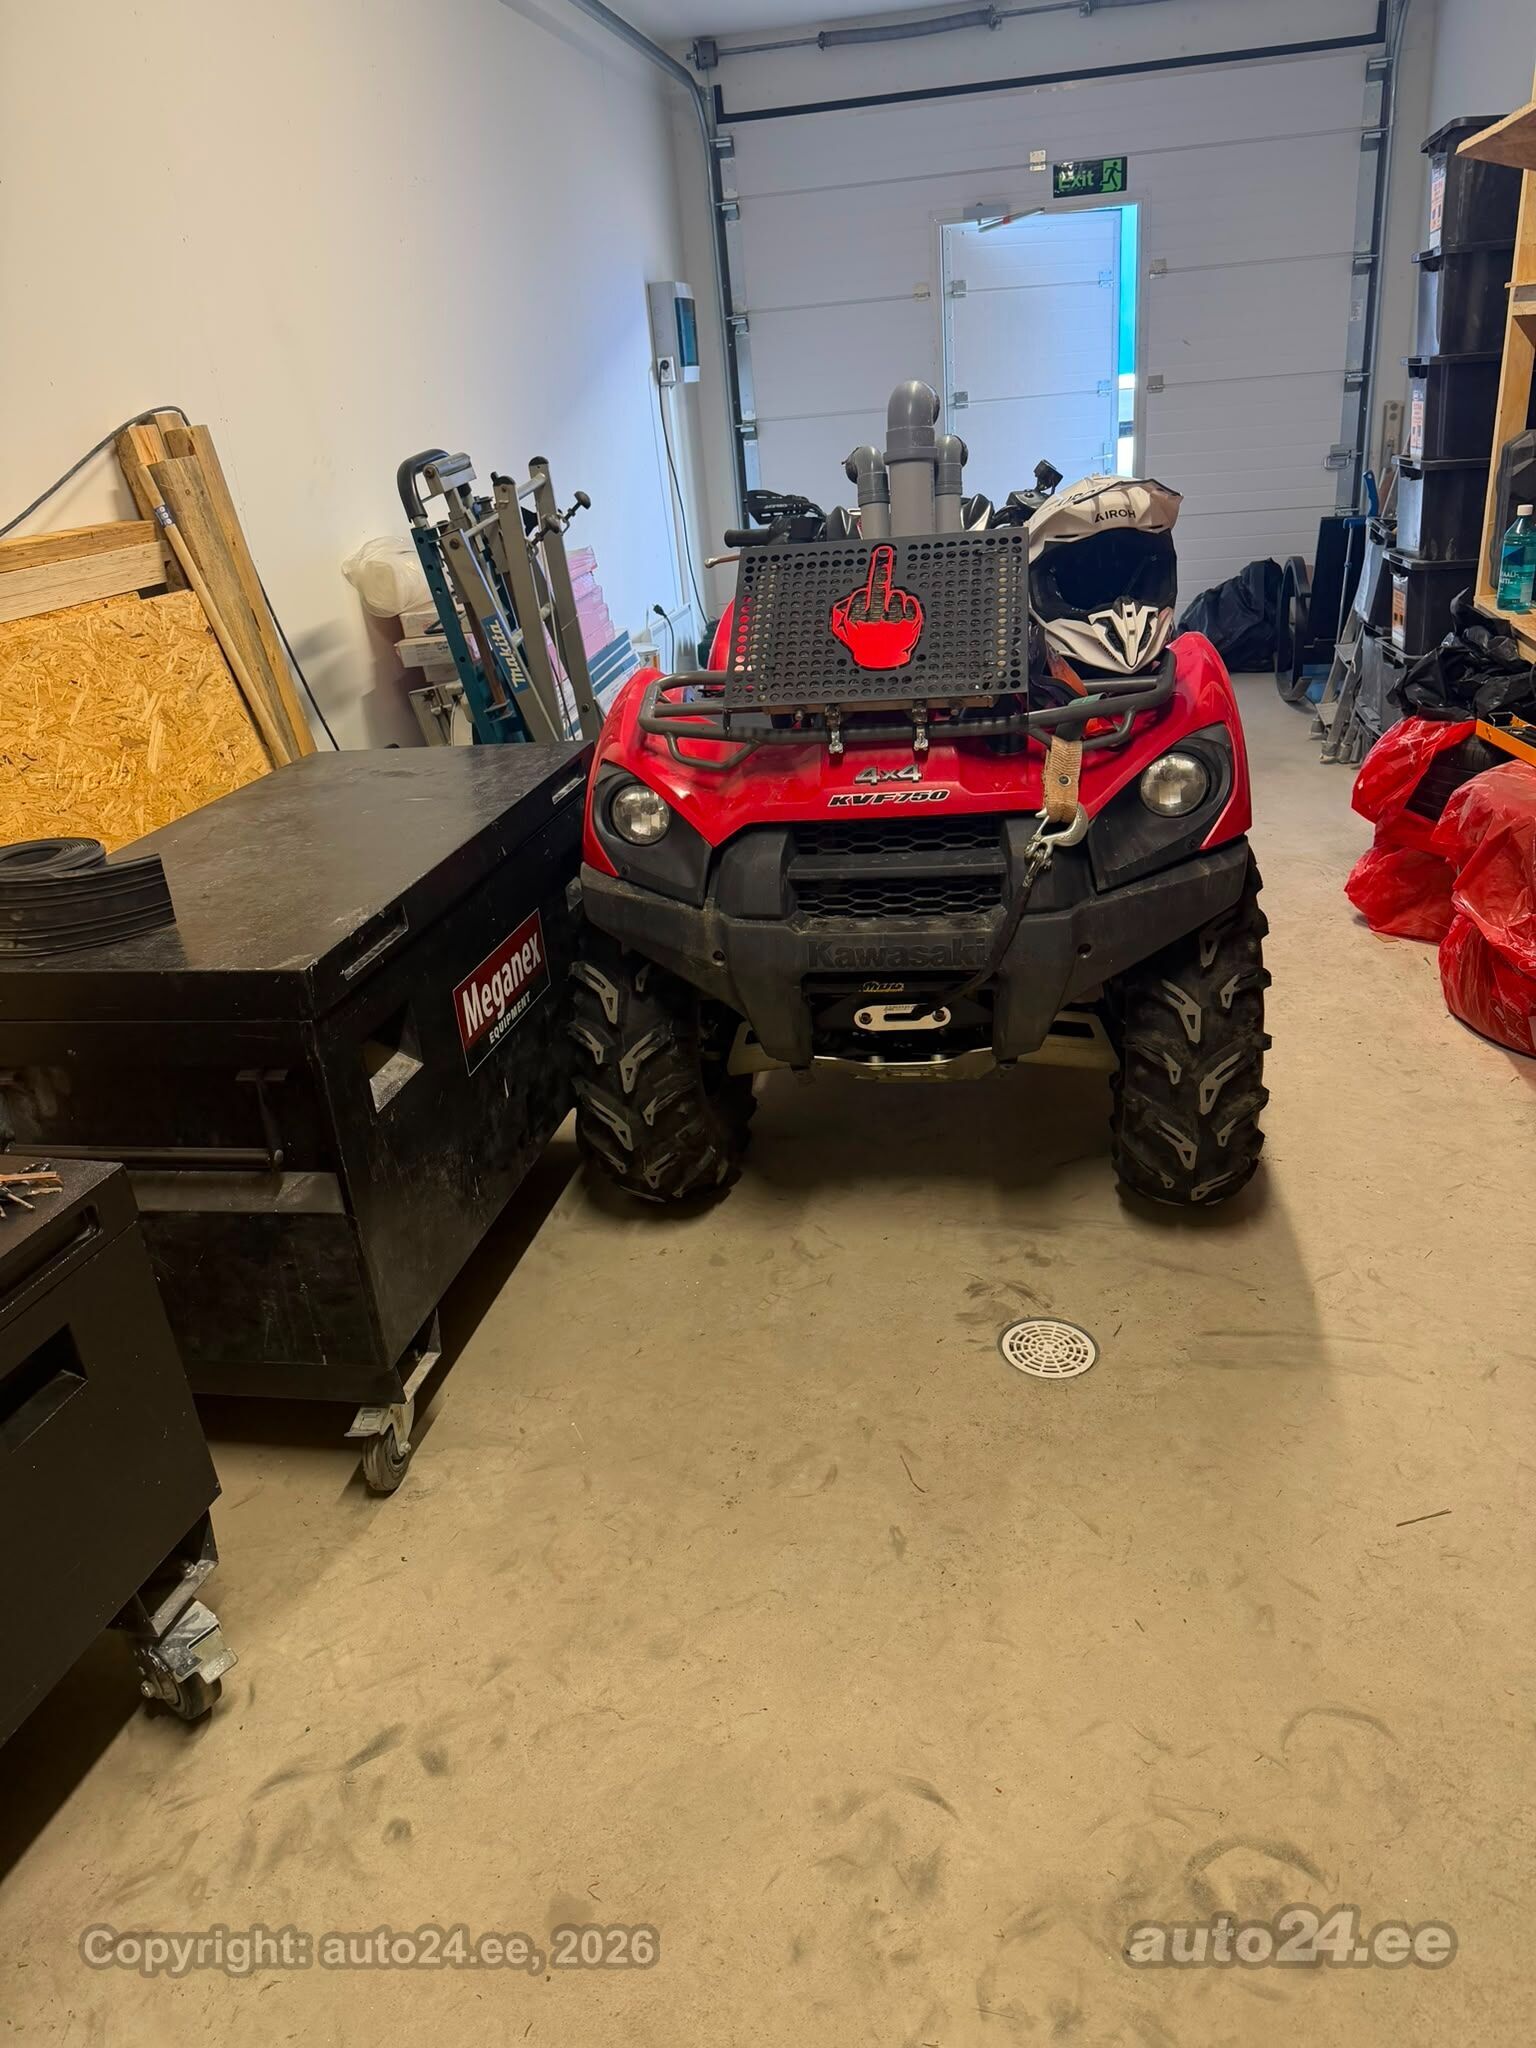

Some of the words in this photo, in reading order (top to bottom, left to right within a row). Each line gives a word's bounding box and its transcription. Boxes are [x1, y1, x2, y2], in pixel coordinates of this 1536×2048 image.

[1059, 169, 1095, 190] Exit
[1094, 509, 1137, 523] AIROH
[490, 619, 526, 688] makita
[854, 764, 923, 786] 4x4
[828, 789, 950, 807] KVF750
[807, 937, 986, 969] Kawasaki
[462, 931, 542, 1038] Meganex
[488, 990, 532, 1045] EQUIPMENT
